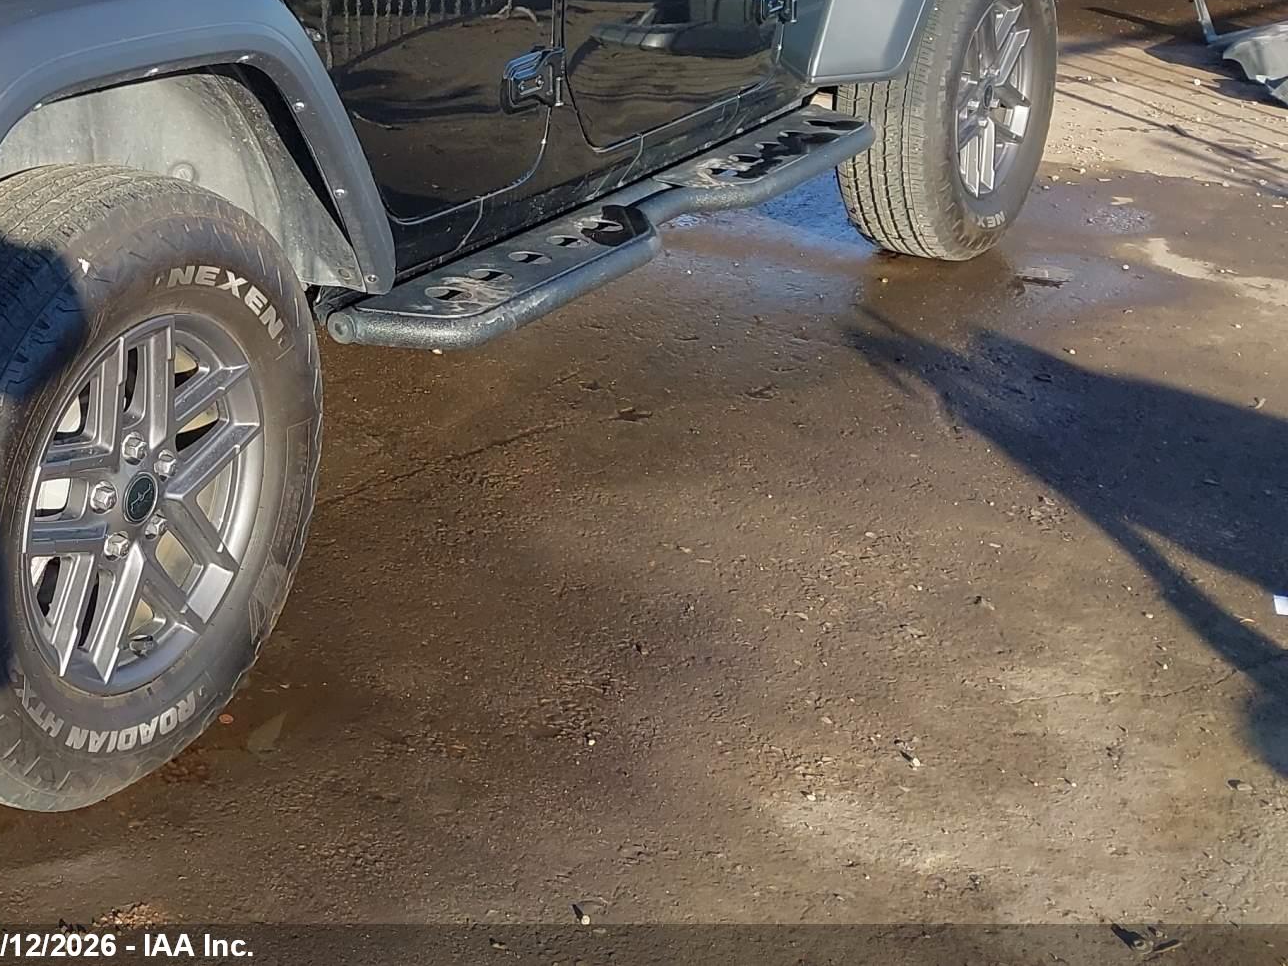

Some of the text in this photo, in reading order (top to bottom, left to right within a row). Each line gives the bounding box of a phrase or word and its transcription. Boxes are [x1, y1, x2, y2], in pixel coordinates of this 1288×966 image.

[974, 210, 1005, 228] NEX
[168, 265, 284, 339] NEXEN
[14, 674, 197, 753] ROADIAN HTX
